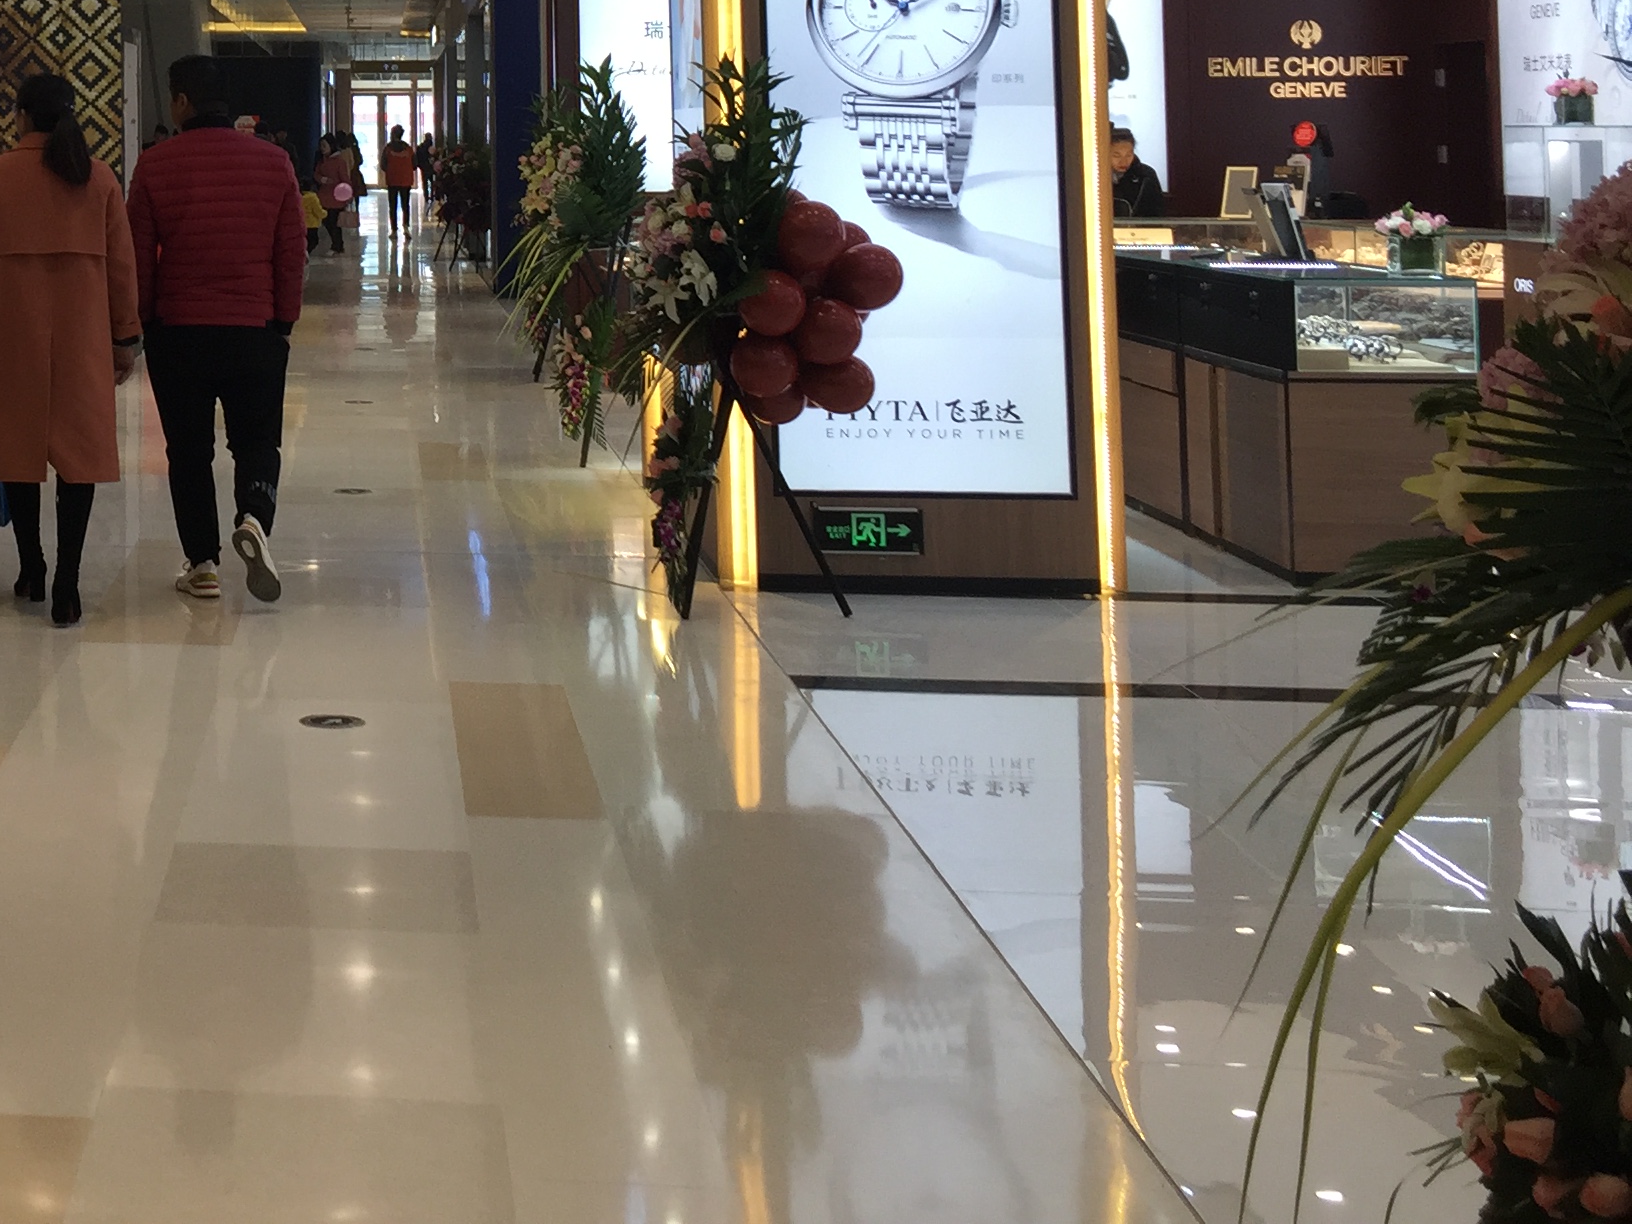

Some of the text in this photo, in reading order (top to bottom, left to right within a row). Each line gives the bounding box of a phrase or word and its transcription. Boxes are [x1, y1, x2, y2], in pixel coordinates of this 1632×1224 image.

[1529, 2, 1561, 20] GENEVE
[644, 20, 671, 39] 瑞
[1207, 55, 1409, 77] EMILE CHOURIET
[1269, 81, 1348, 98] GENEVE
[945, 398, 1025, 424] 飞亚达
[825, 427, 1026, 440] ENJOY YOUR TIME
